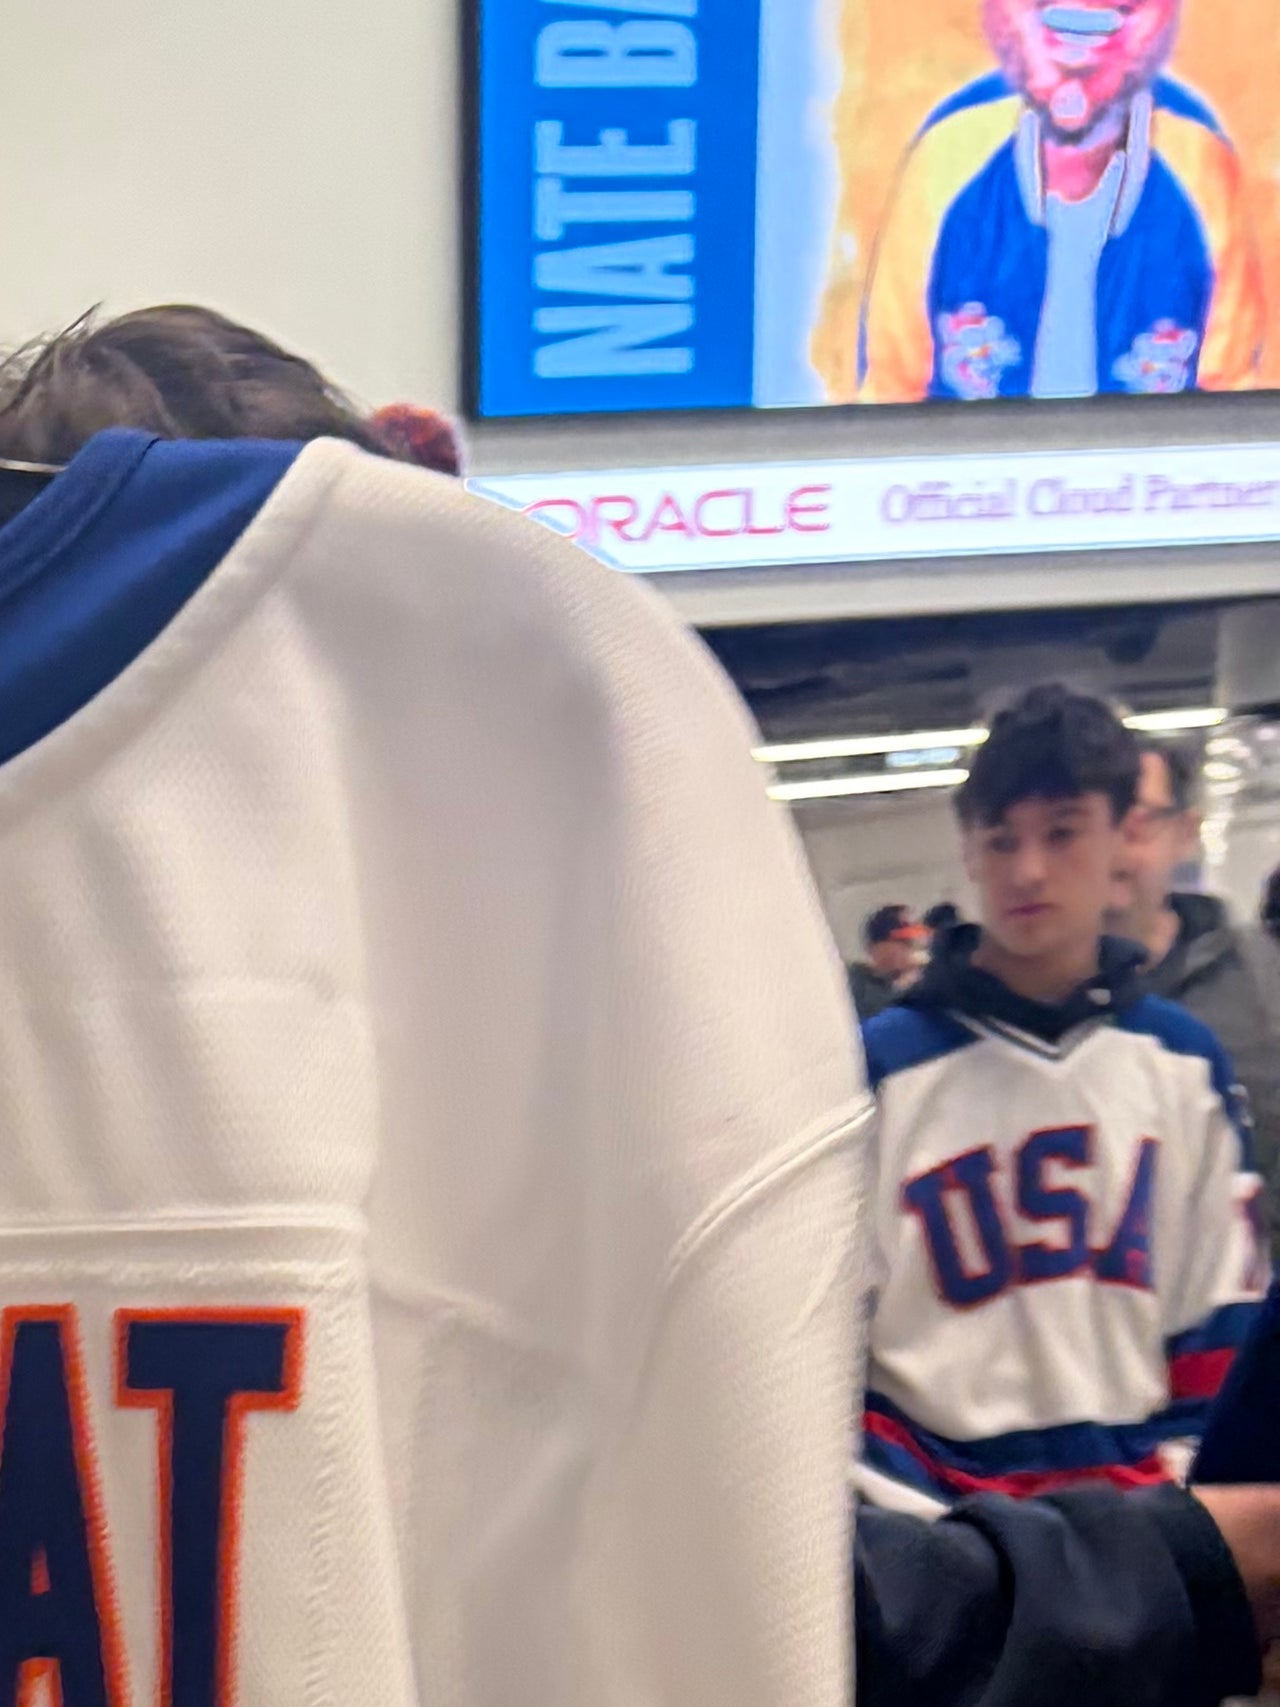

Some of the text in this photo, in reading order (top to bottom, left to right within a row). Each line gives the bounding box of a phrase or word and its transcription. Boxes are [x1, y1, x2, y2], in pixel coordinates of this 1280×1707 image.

[532, 0, 698, 379] NATE B
[521, 470, 1277, 543] ORACLE Official Cloud Partner
[900, 1122, 1160, 1312] USA
